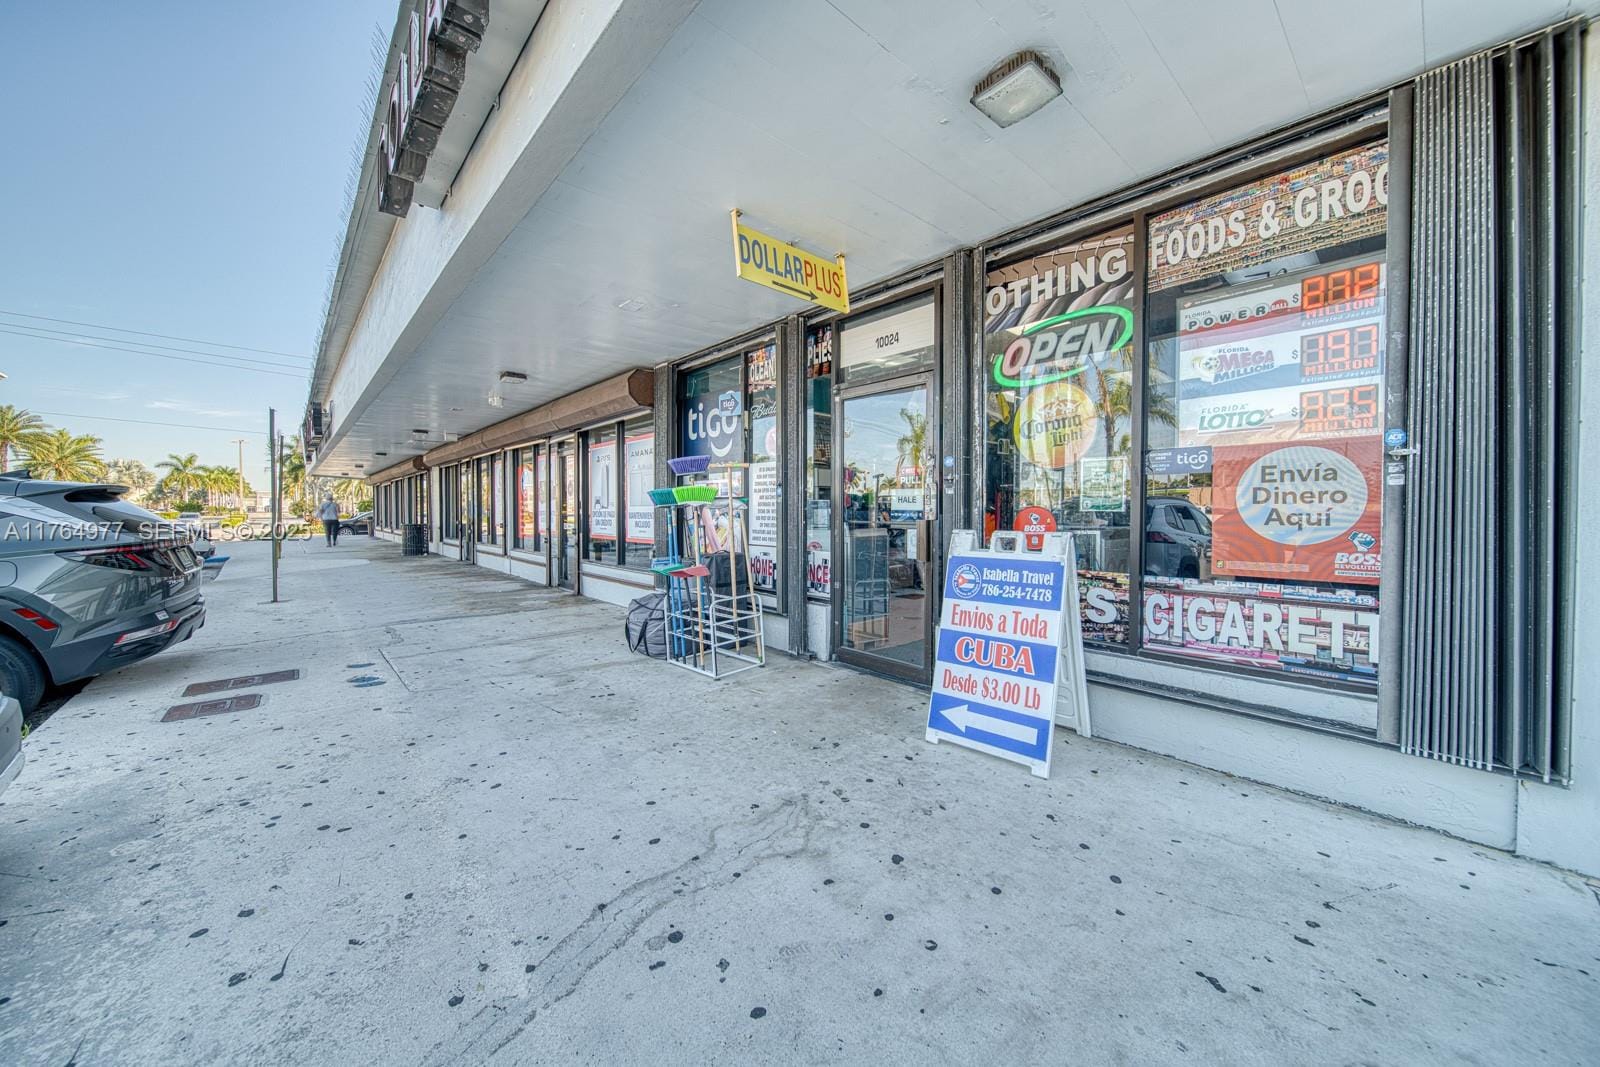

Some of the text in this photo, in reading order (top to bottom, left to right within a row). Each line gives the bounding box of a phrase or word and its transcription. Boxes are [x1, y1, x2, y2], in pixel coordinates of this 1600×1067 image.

[1150, 163, 1388, 271] FOODS & GROC
[985, 247, 1127, 315] OTHING
[1184, 310, 1211, 319] FLORIDA
[1305, 297, 1375, 319] MILLION
[875, 331, 900, 349] 10024
[1002, 317, 1119, 377] OPEN
[1216, 350, 1275, 373] MEGA
[1304, 358, 1374, 376] MILLION
[1212, 362, 1275, 384] MILLIONS
[1199, 409, 1265, 431] LOTTO
[1201, 404, 1246, 415] FLORIDA
[1260, 463, 1339, 483] Envía
[897, 495, 917, 504] HALE
[1252, 486, 1348, 505] Dinero
[1024, 524, 1046, 532] BOSS
[1263, 508, 1332, 531] Aquí
[750, 558, 773, 577] HOME
[983, 567, 1054, 586] Isabella Travel
[982, 583, 1052, 602] 786-254-7478
[951, 603, 1048, 640] Envios a Toda
[1145, 593, 1380, 664] CIGARETT
[955, 636, 1035, 676] CUBA
[943, 669, 1041, 711] Desde $3.00 Lb
